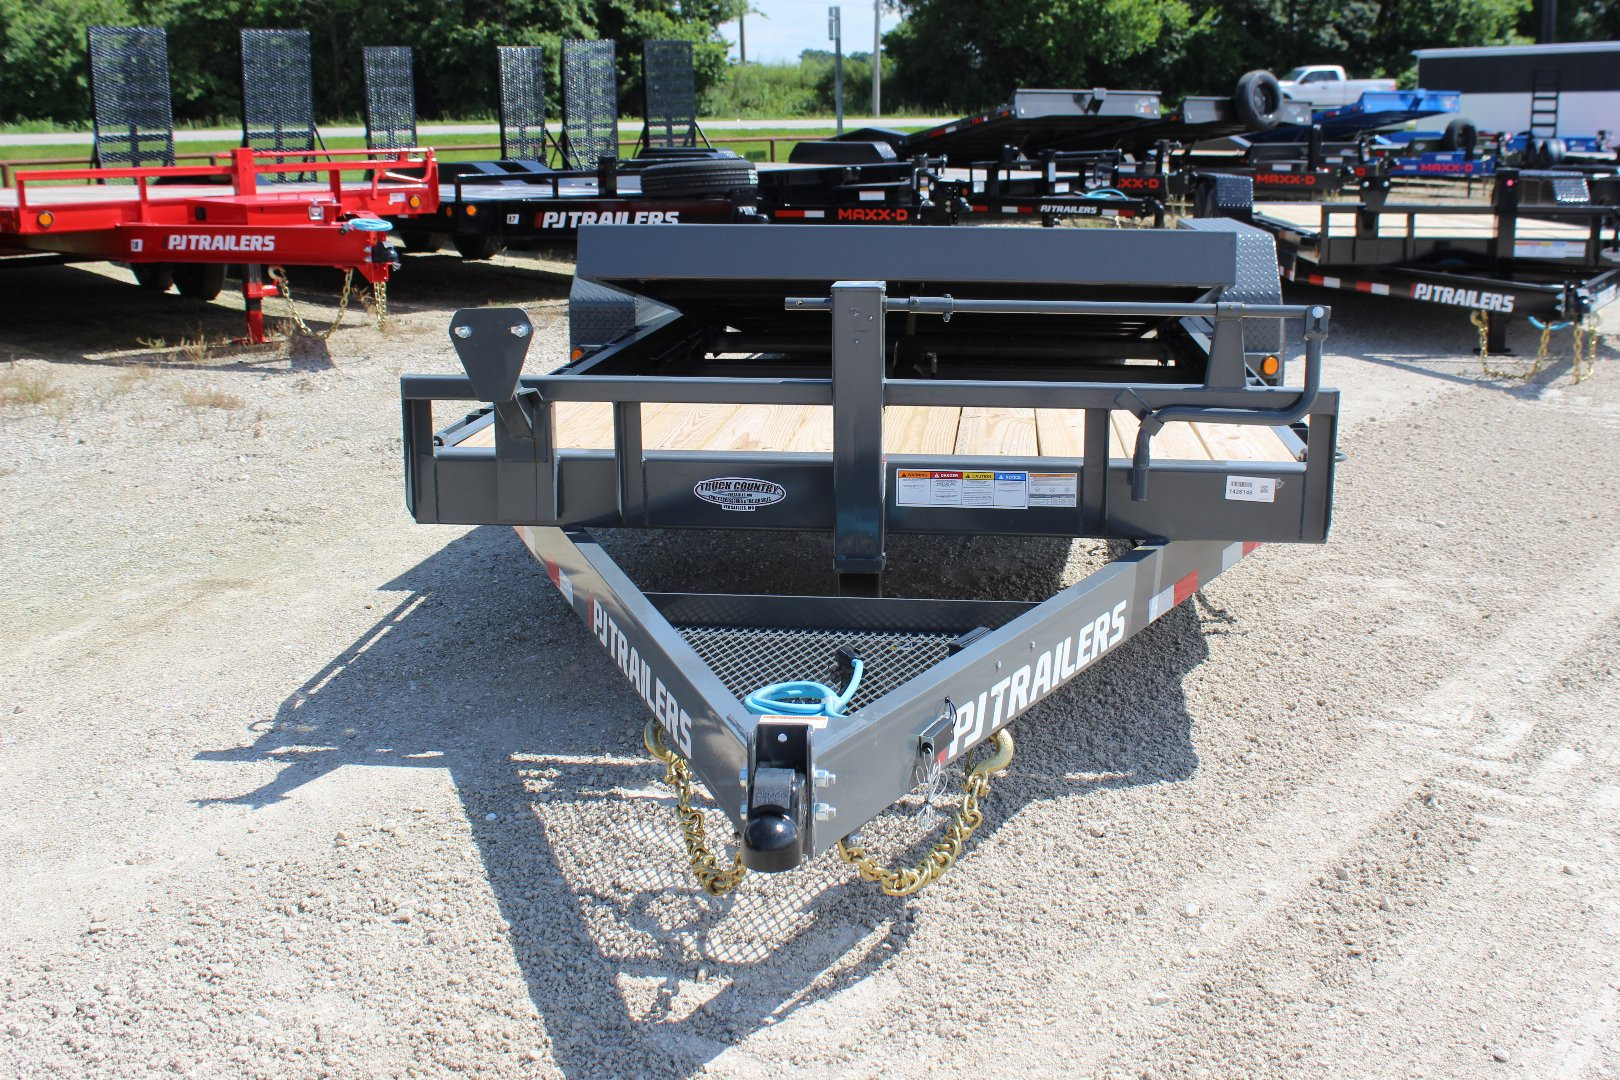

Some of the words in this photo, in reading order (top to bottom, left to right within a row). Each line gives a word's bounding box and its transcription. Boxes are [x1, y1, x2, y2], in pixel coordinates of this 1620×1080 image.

[1421, 163, 1474, 172] MAXX-D
[1117, 178, 1160, 189] XX-D
[1256, 174, 1315, 185] MAXX-D
[838, 208, 908, 221] MAXX-D
[189, 234, 275, 251] TRAILERS
[1432, 285, 1515, 313] TRAILERS
[699, 481, 732, 491] TRUCK
[733, 481, 780, 493] COUNTRY
[989, 600, 1127, 732] TRAILERS
[609, 617, 691, 760] TRAILERS
